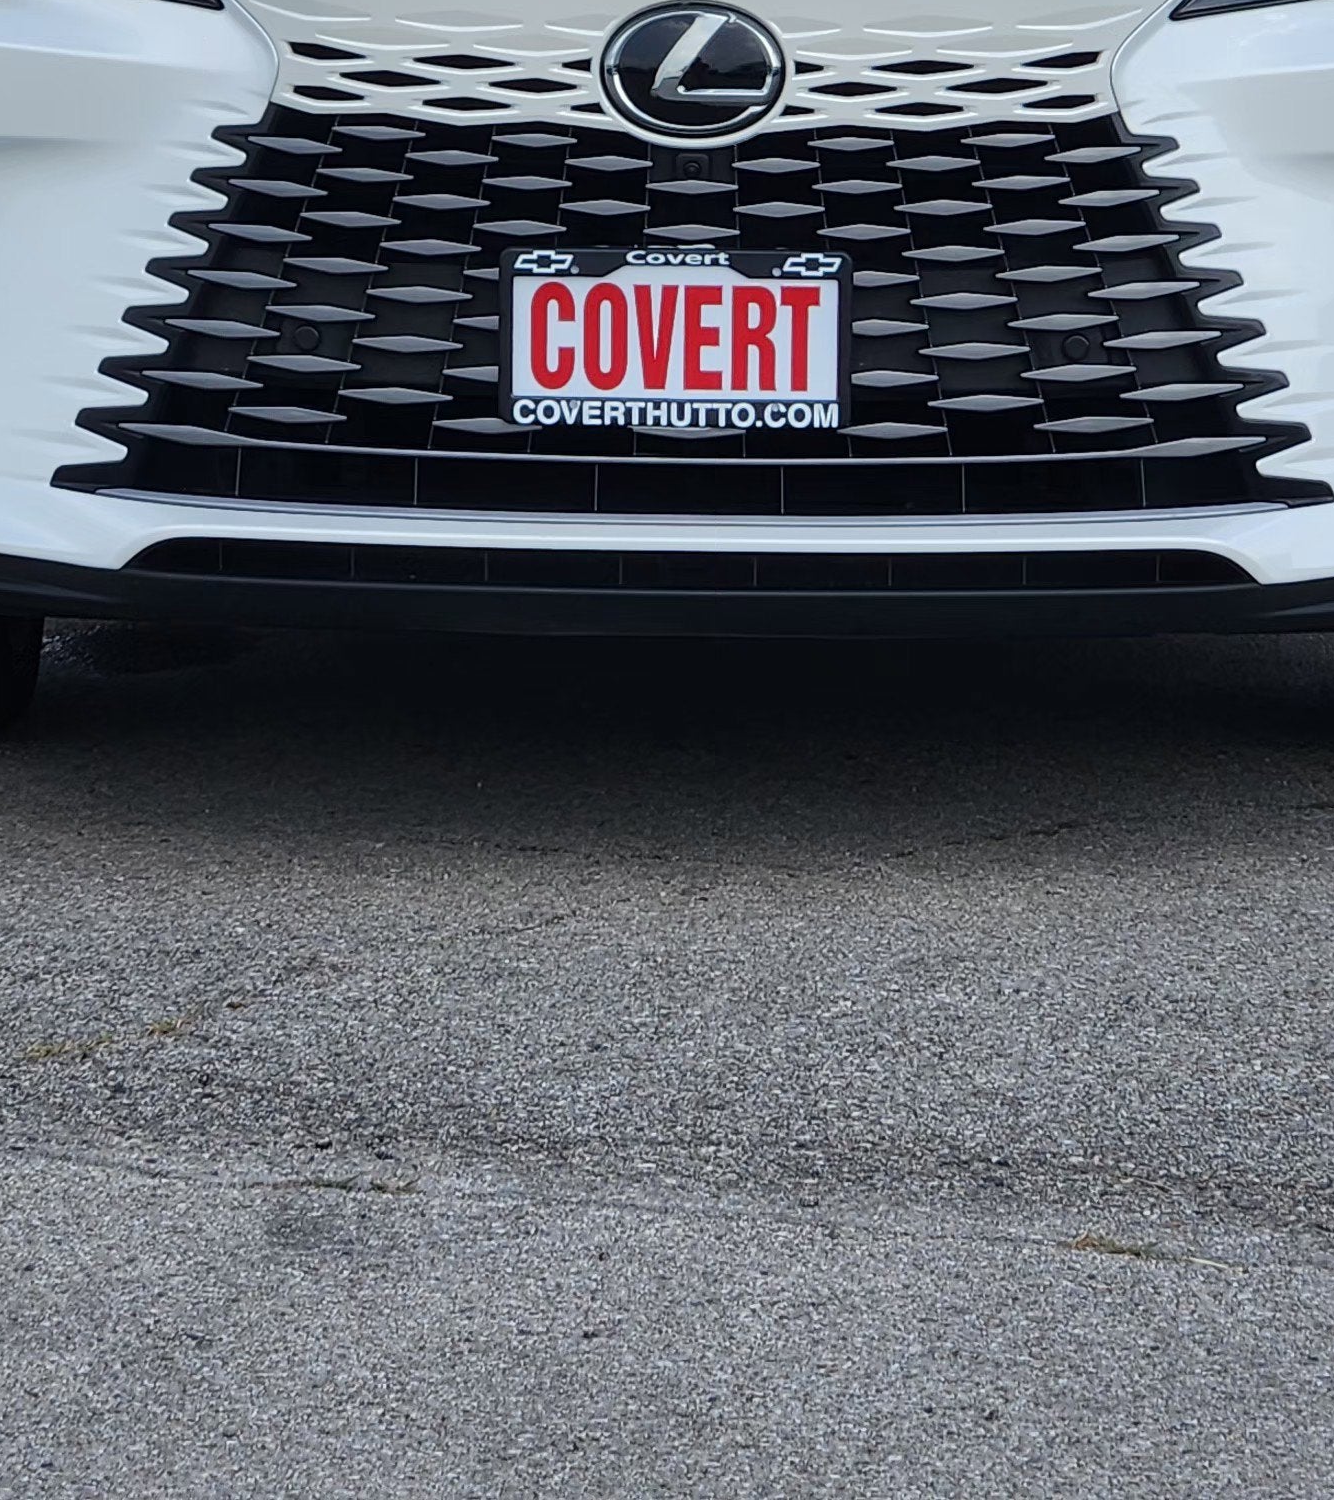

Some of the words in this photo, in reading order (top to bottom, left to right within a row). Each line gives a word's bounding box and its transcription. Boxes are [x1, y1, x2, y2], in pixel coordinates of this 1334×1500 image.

[625, 250, 731, 267] Covert
[530, 281, 822, 392] COVERT
[512, 399, 839, 429] COVERTHUTTO.COM
